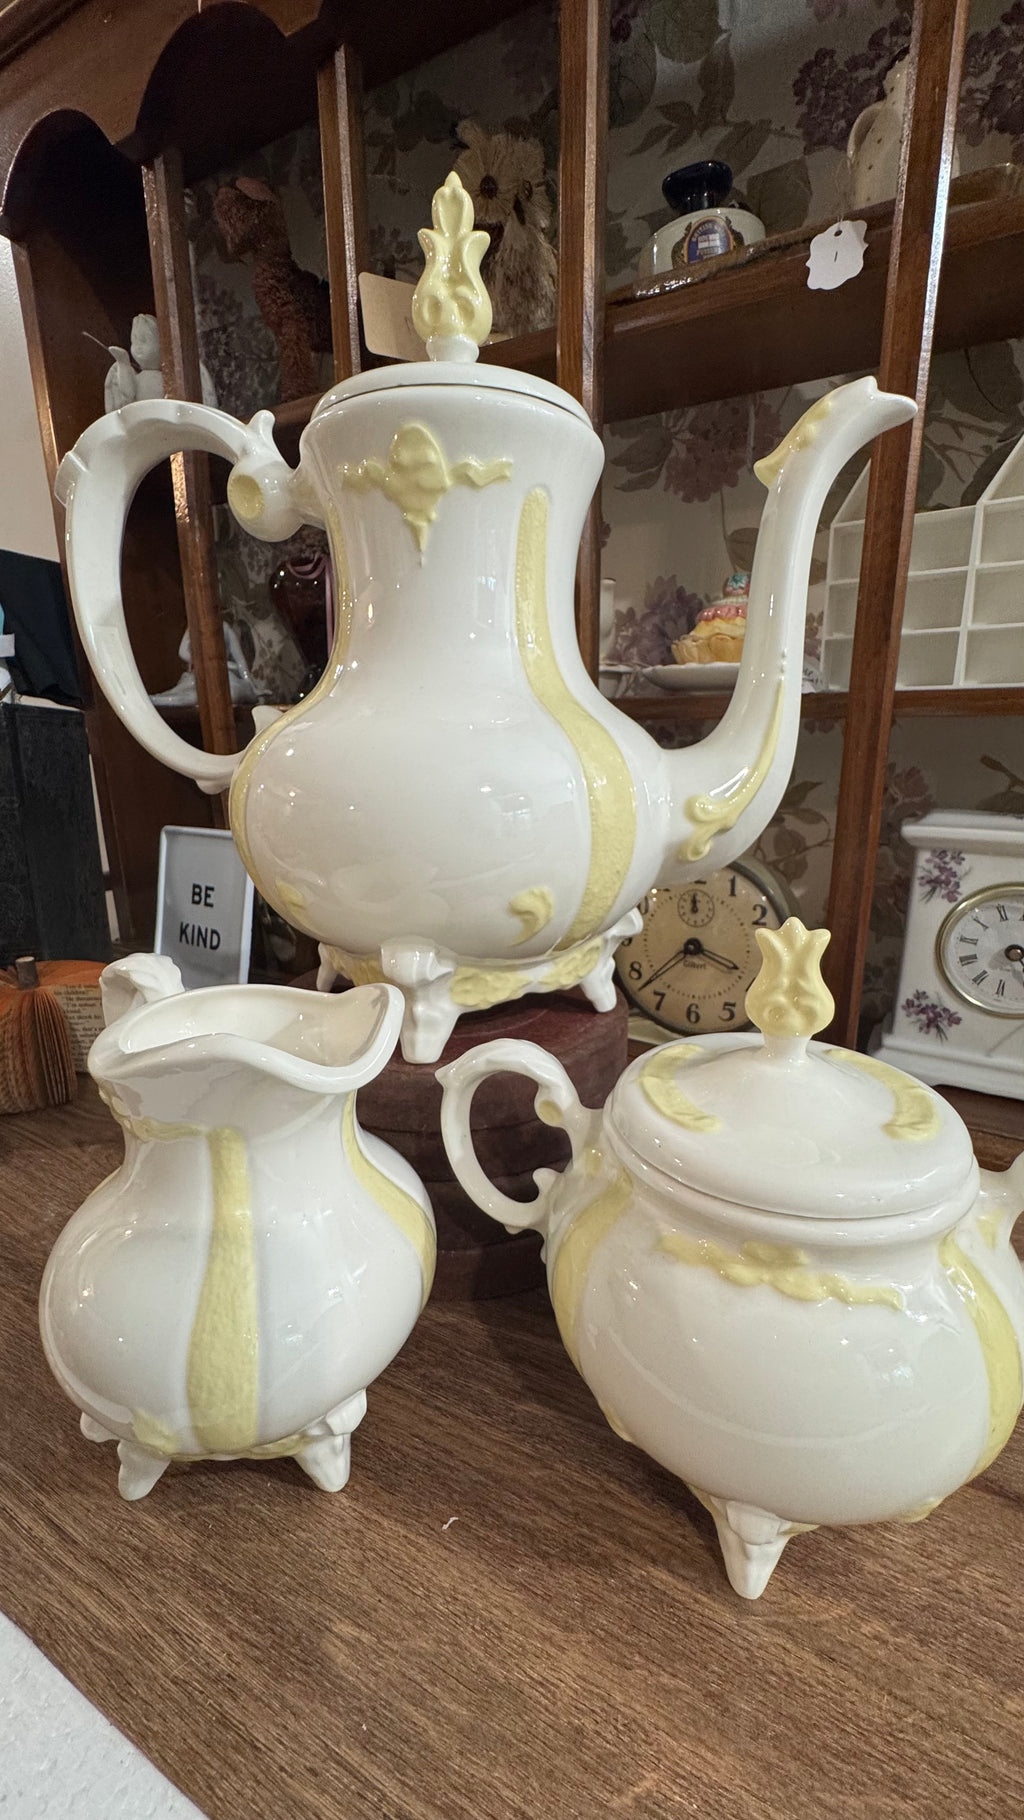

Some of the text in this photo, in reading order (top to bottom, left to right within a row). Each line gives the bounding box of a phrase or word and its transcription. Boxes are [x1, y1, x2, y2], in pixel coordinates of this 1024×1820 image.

[191, 883, 215, 908] BE
[729, 875, 737, 898] 1
[752, 903, 768, 927] 2
[179, 921, 221, 951] KIND
[628, 960, 643, 981] 8
[653, 990, 667, 1012] 7
[718, 1001, 737, 1023] 5
[686, 1003, 701, 1024] 6
